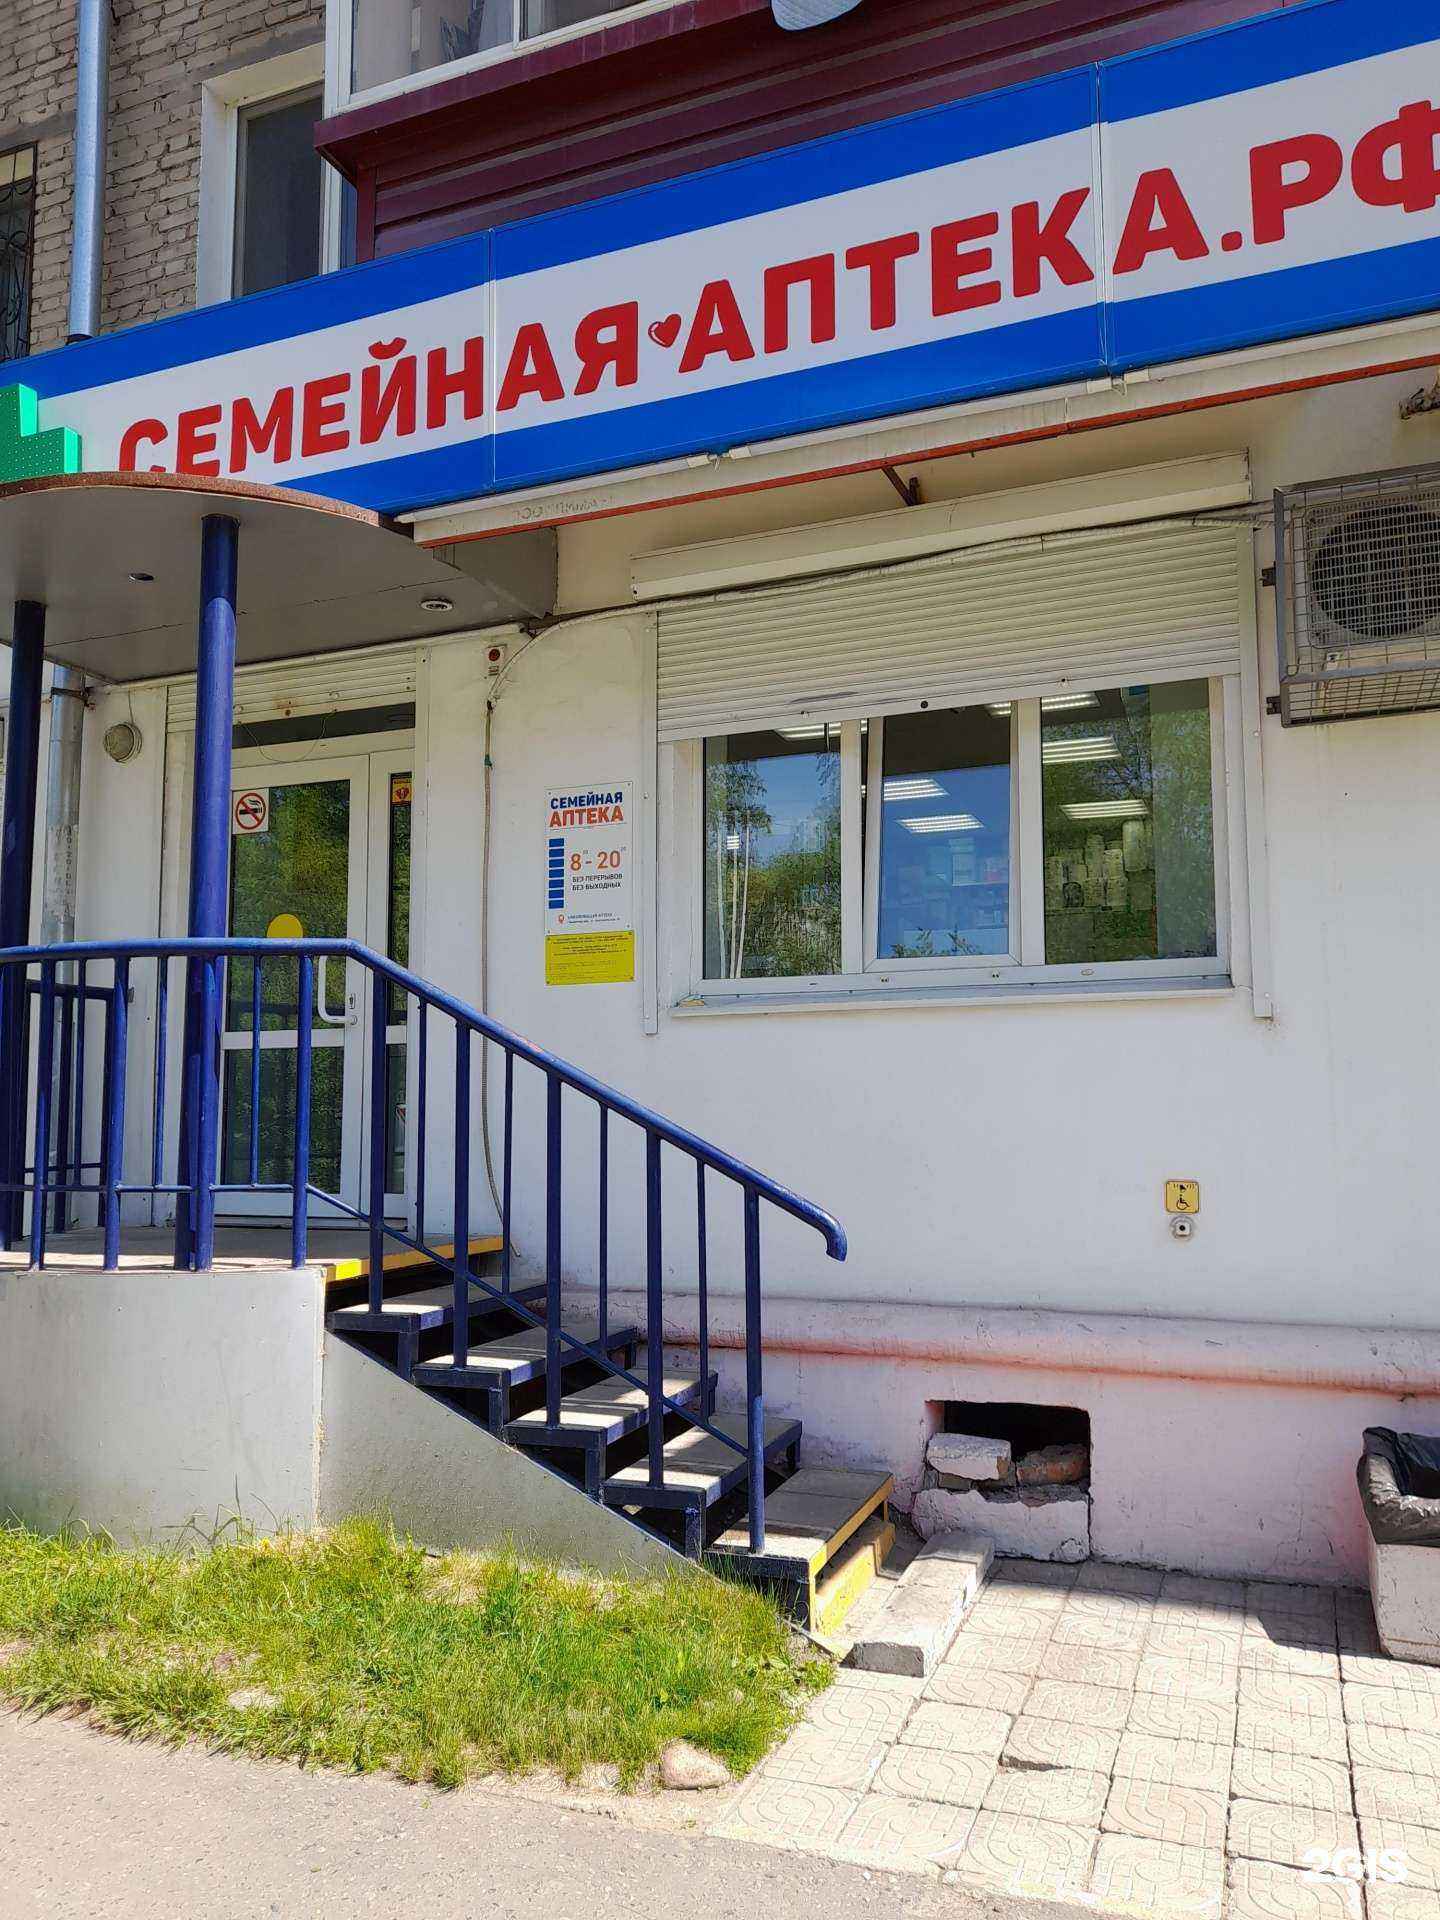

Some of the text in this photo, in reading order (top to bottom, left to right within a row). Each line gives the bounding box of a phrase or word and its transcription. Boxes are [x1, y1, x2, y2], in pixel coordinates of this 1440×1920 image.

[118, 300, 640, 478] СЕМЕЙНАЯ
[550, 791, 623, 810] СЕМЕЙНАЯ
[549, 805, 624, 827] АПТЕКА
[585, 881, 622, 890] ВЫХОДНЫХ
